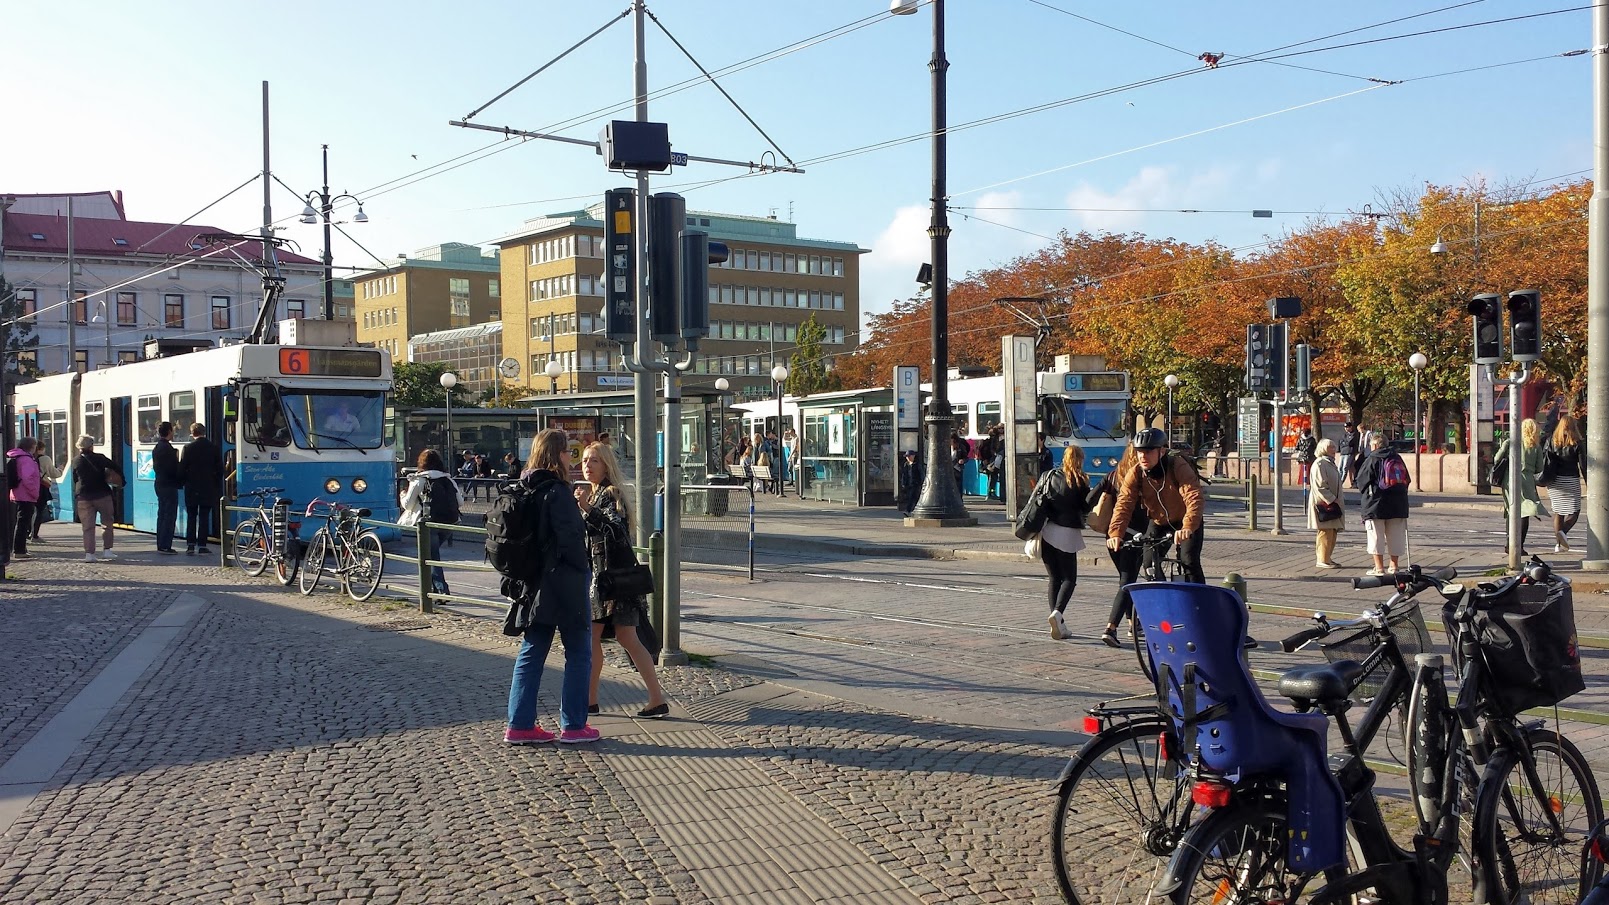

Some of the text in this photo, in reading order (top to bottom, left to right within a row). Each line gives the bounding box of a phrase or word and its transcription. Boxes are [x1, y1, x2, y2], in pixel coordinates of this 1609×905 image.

[1020, 342, 1028, 362] D
[288, 351, 302, 373] 6
[904, 371, 913, 386] B
[1070, 376, 1078, 390] 9
